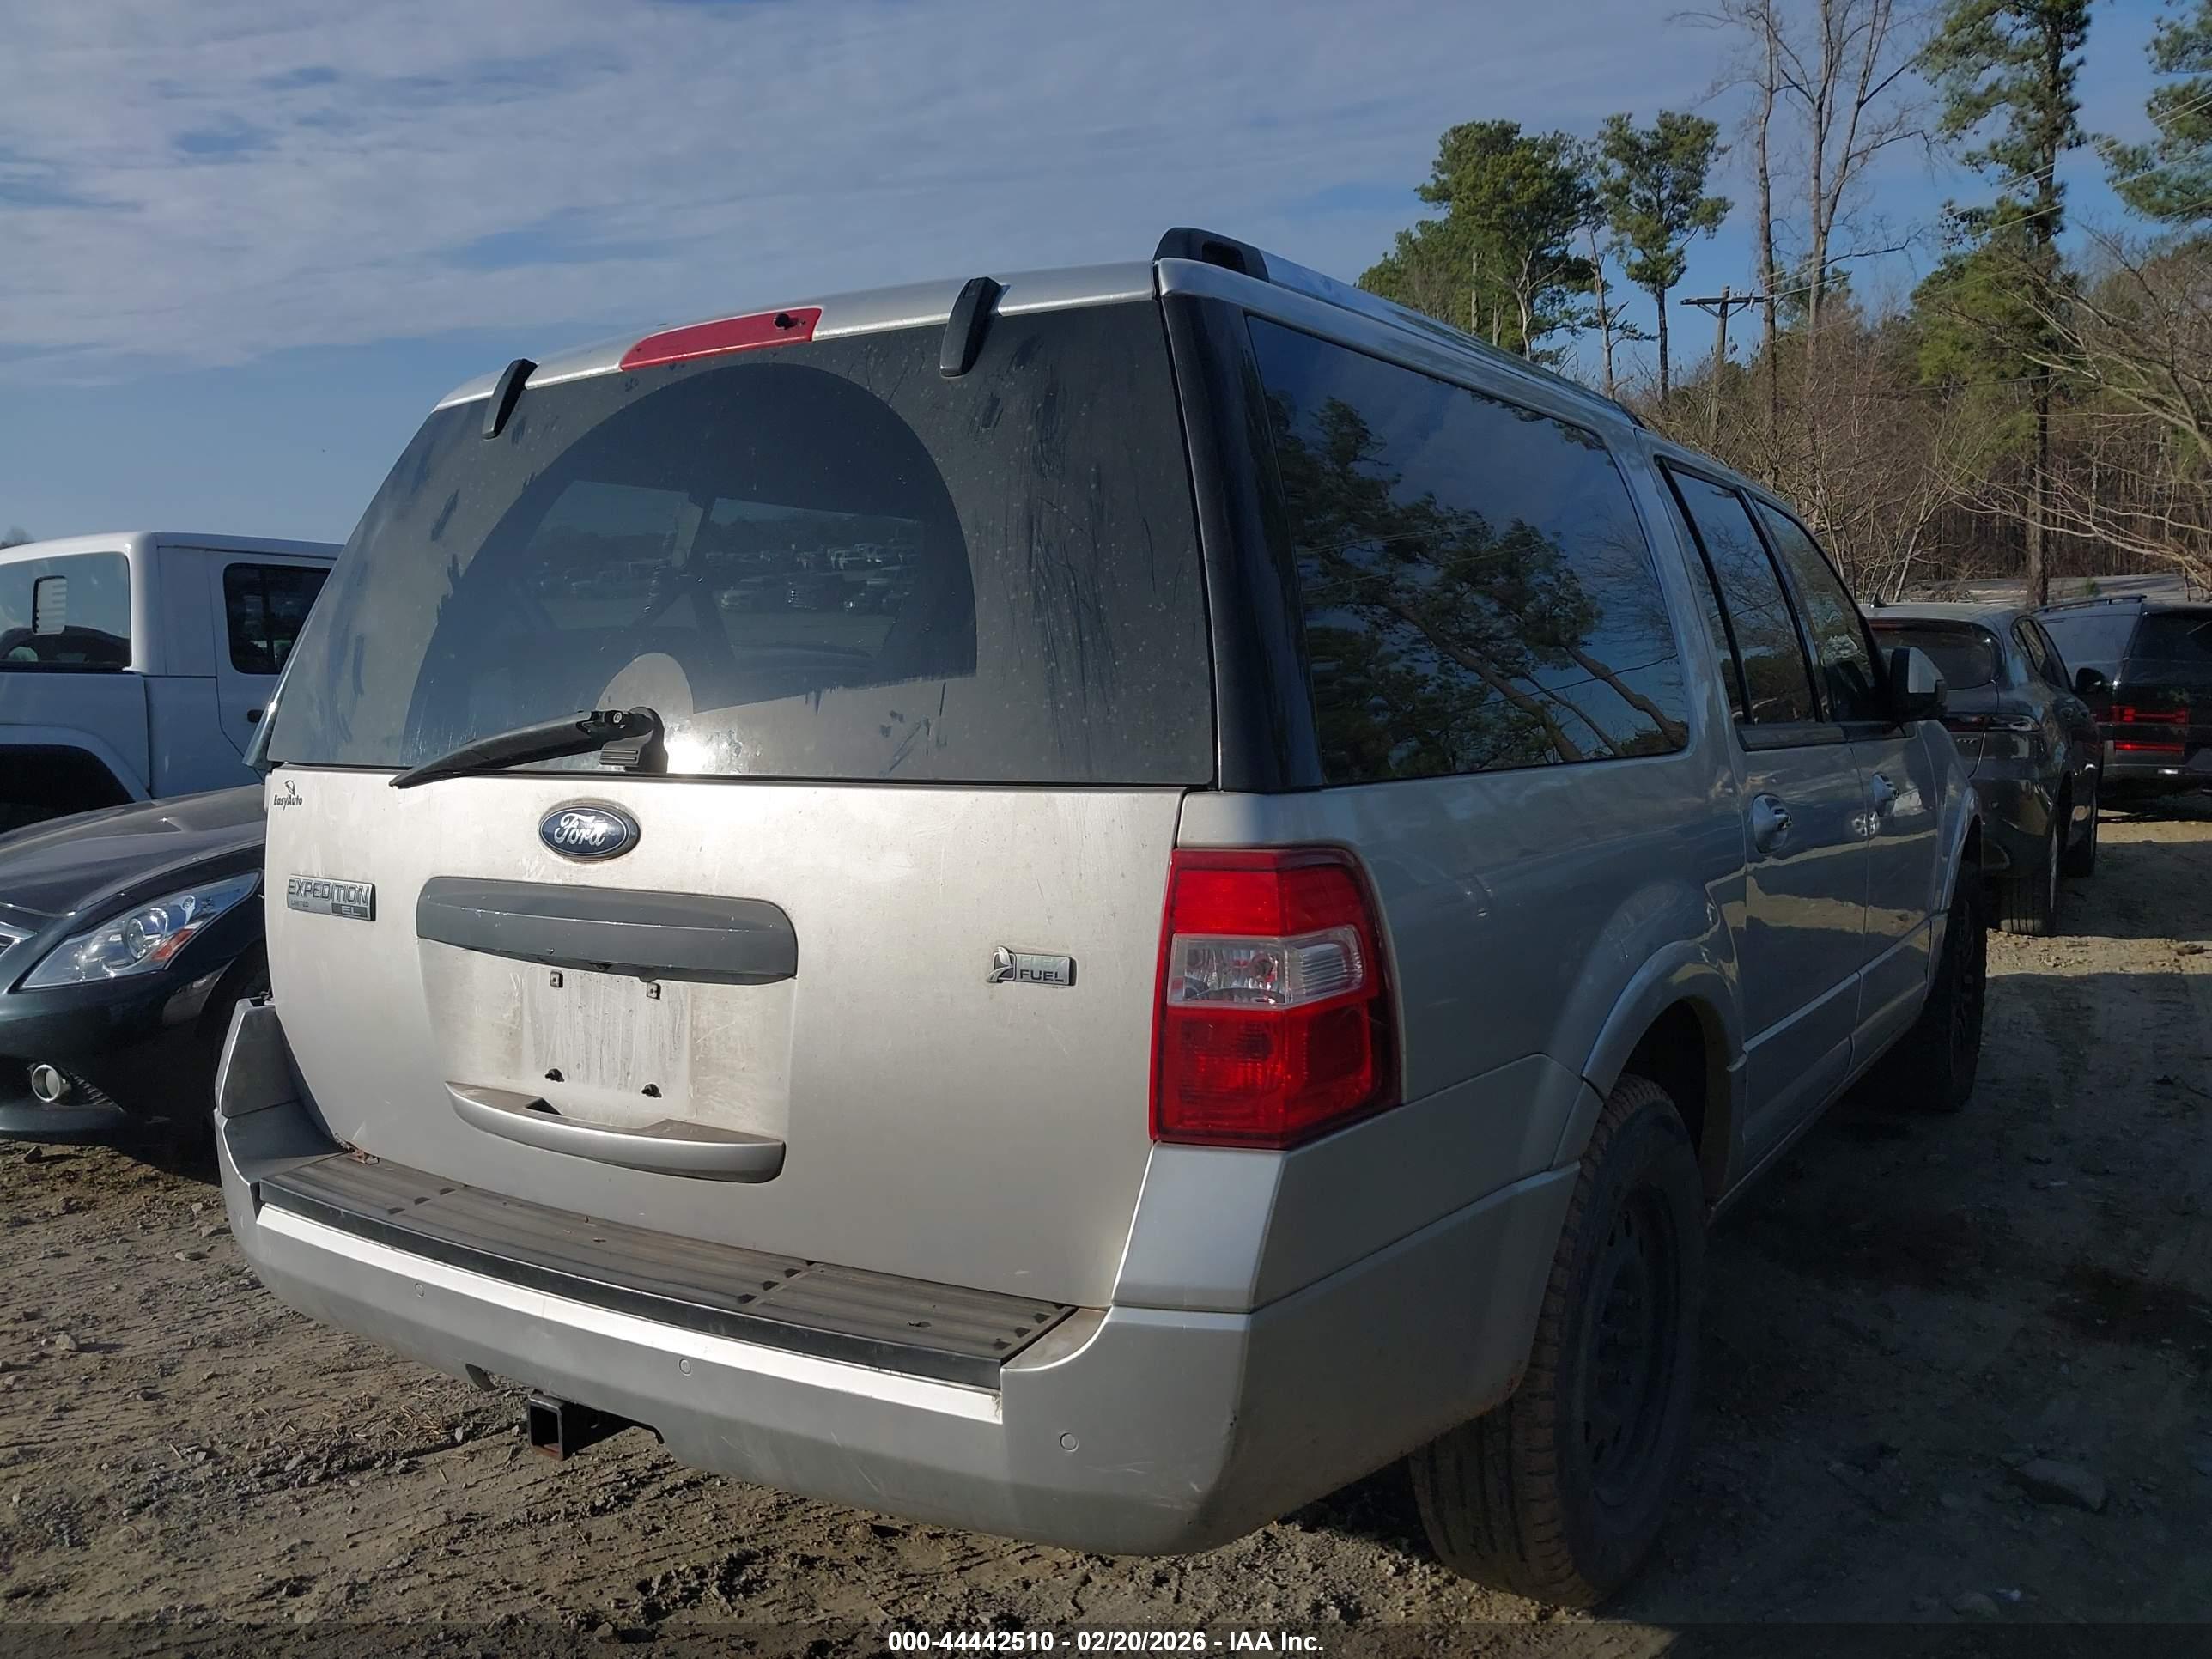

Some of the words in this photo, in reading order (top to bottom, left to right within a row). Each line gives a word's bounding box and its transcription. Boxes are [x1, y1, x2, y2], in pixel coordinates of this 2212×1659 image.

[273, 794, 303, 811] EasyAuto
[554, 812, 608, 847] Ford
[288, 878, 369, 906] EXPEDITION
[341, 906, 362, 915] EL
[1019, 969, 1065, 982] FUEL
